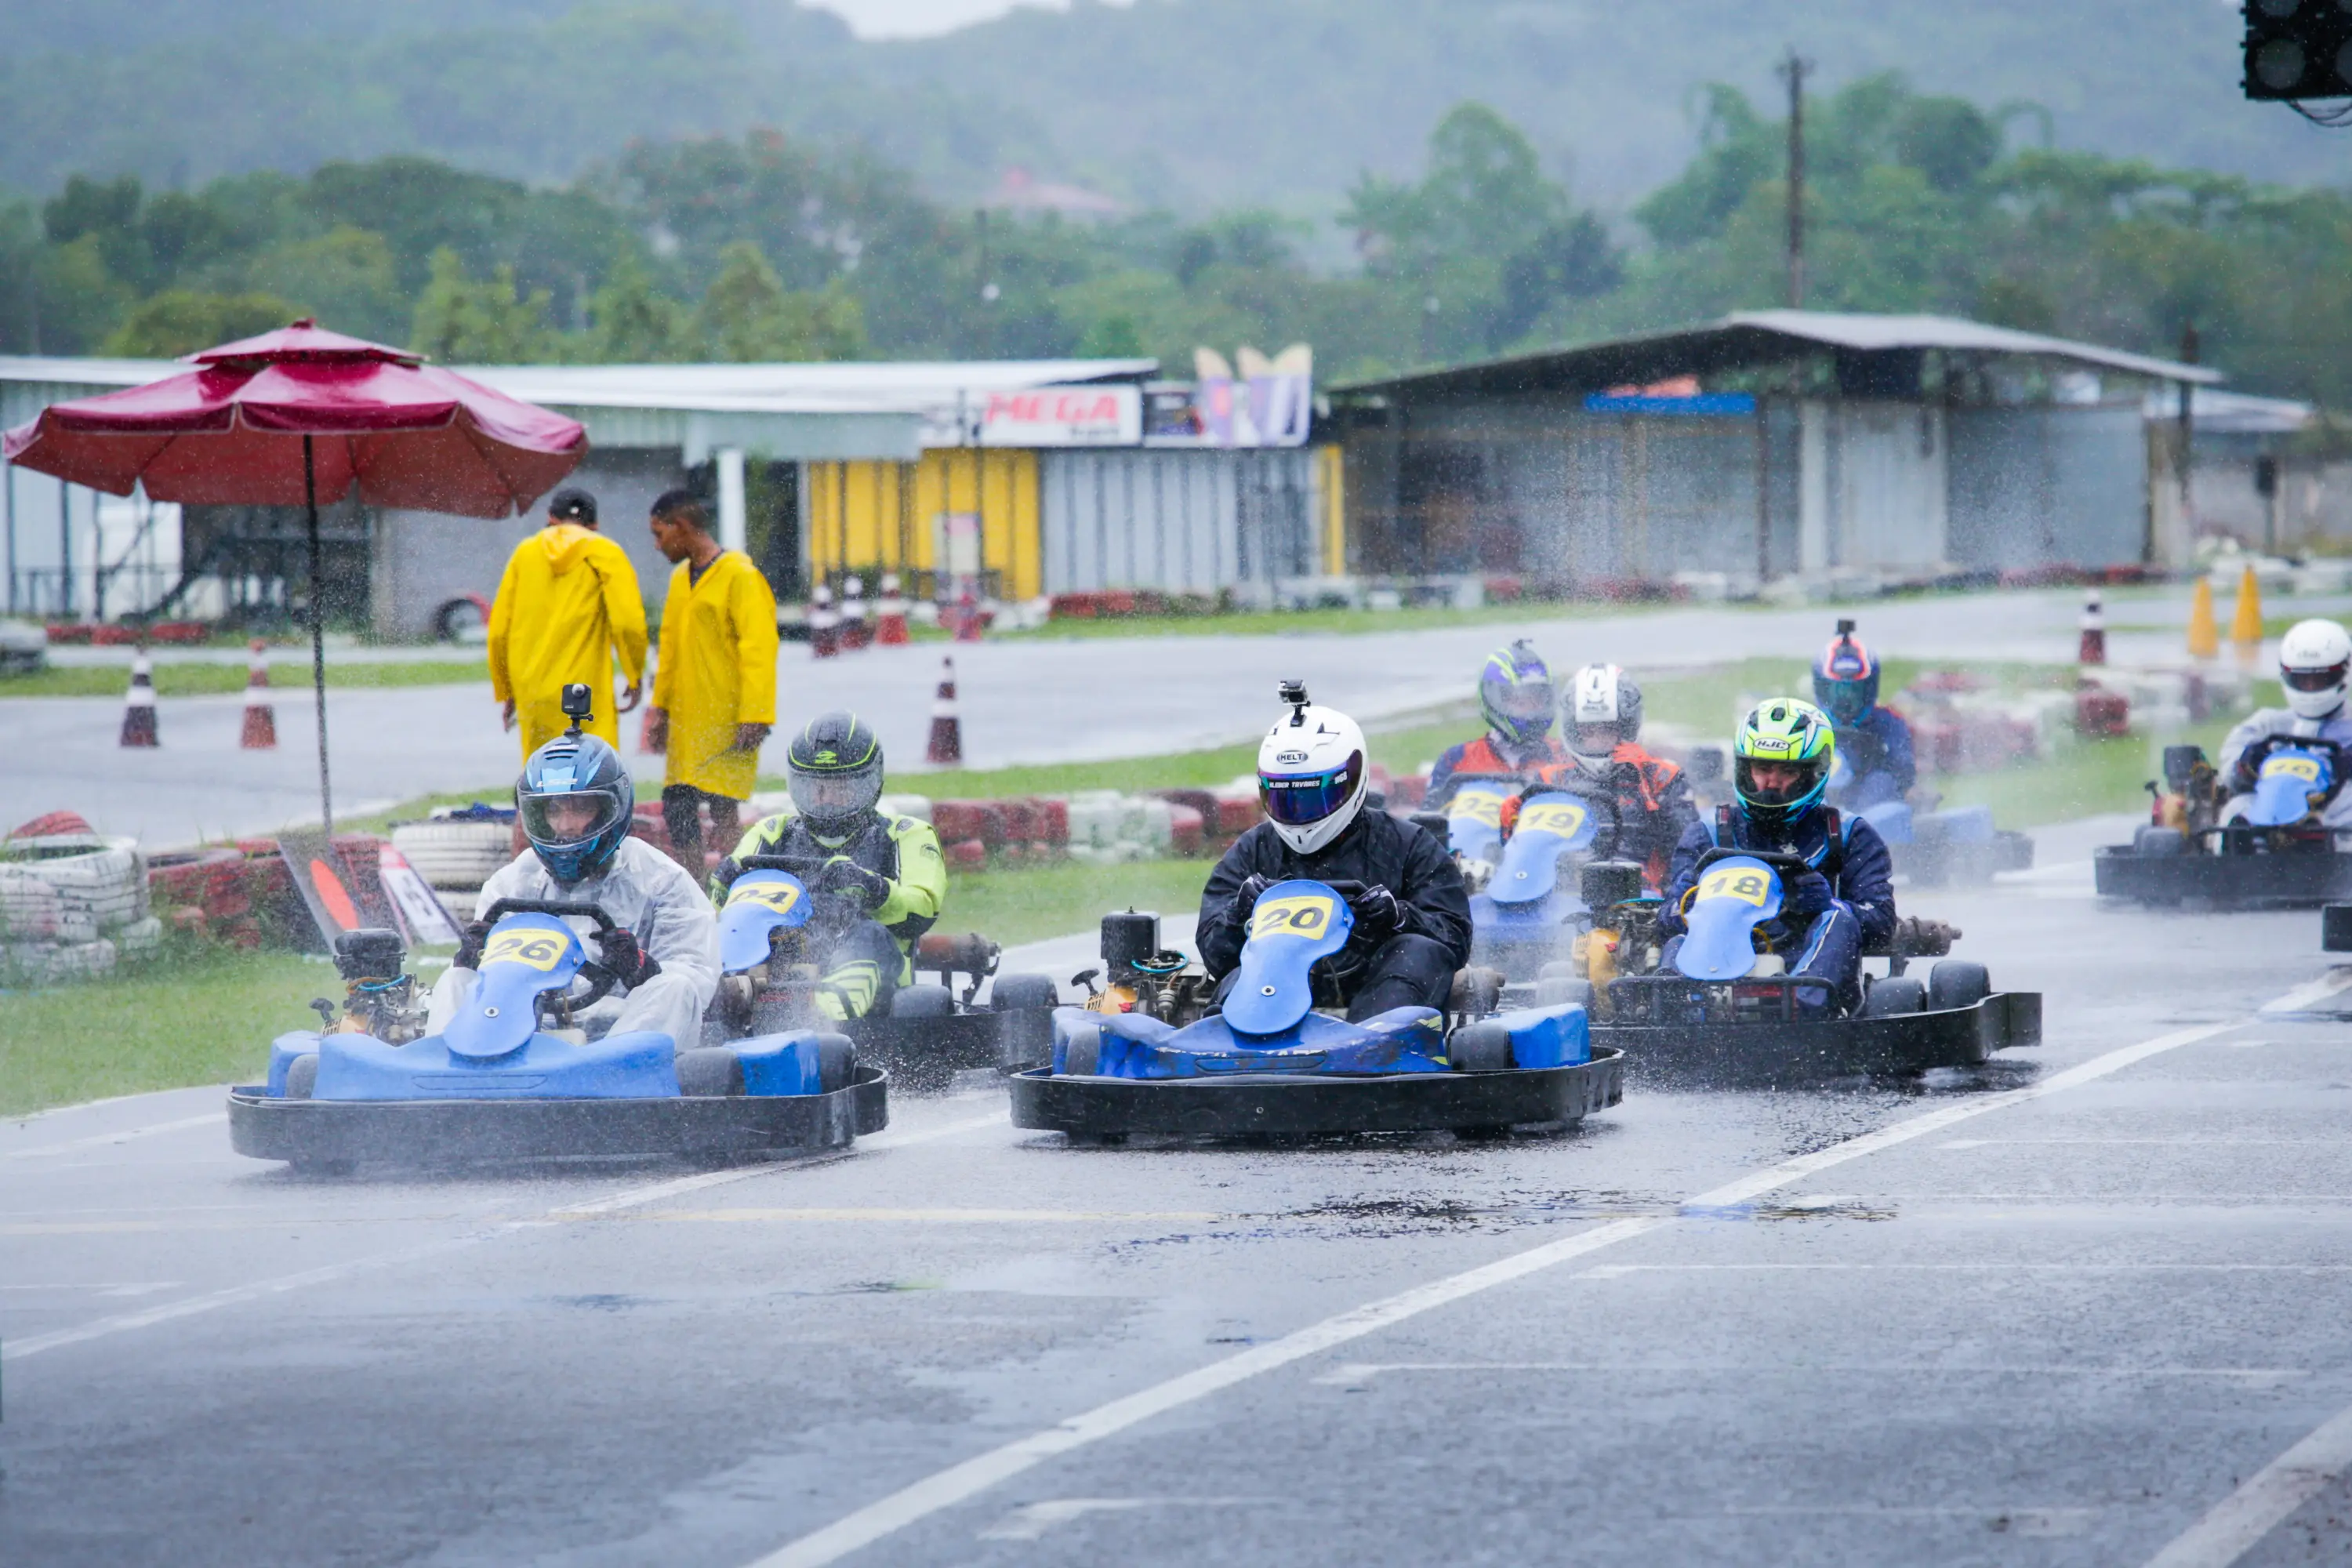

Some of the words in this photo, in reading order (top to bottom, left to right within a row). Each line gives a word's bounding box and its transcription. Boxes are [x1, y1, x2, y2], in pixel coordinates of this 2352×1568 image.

[985, 394, 1119, 421] MEGA
[1757, 741, 1787, 750] HJC
[1528, 811, 1575, 829] 19
[1709, 876, 1764, 898] 18
[1255, 906, 1325, 931] 20
[481, 938, 558, 962] 26
